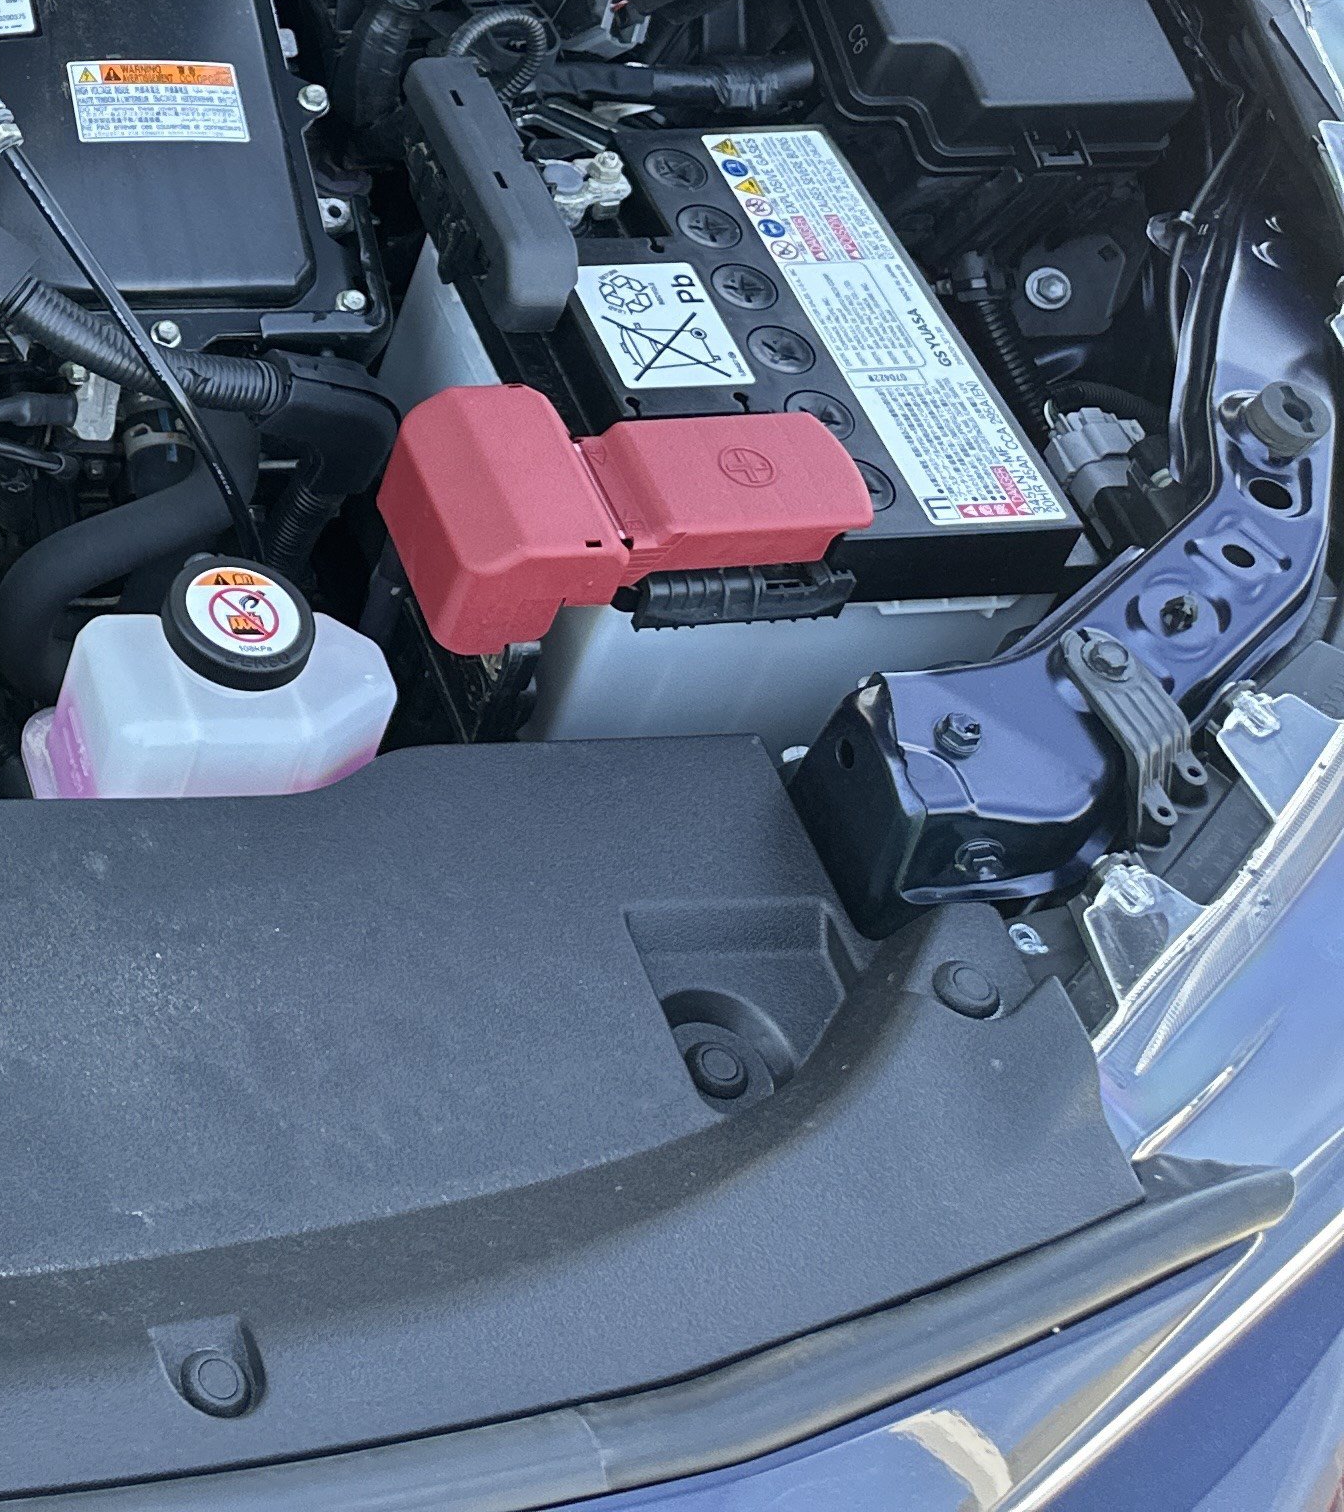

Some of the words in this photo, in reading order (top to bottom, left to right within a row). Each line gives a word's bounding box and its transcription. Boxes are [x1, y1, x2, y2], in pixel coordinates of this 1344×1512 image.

[848, 24, 868, 54] C6
[120, 64, 161, 74] WARNING
[742, 138, 769, 165] GASES
[775, 137, 799, 158] BURNS
[790, 161, 816, 184] SEVERE
[760, 168, 799, 213] EXPLOSIVE
[806, 187, 833, 212] CAUSES
[825, 215, 857, 249] POISON
[670, 274, 704, 304] Pb
[907, 308, 941, 349] YUASA
[932, 350, 953, 366] GS
[964, 380, 1003, 424] 295A(EN)
[994, 427, 1019, 449] CCA
[994, 445, 1047, 513] 345LN1-MF
[1012, 455, 1039, 481] 45Ah
[991, 466, 1024, 501] DANGER
[1031, 485, 1059, 512] 20HR
